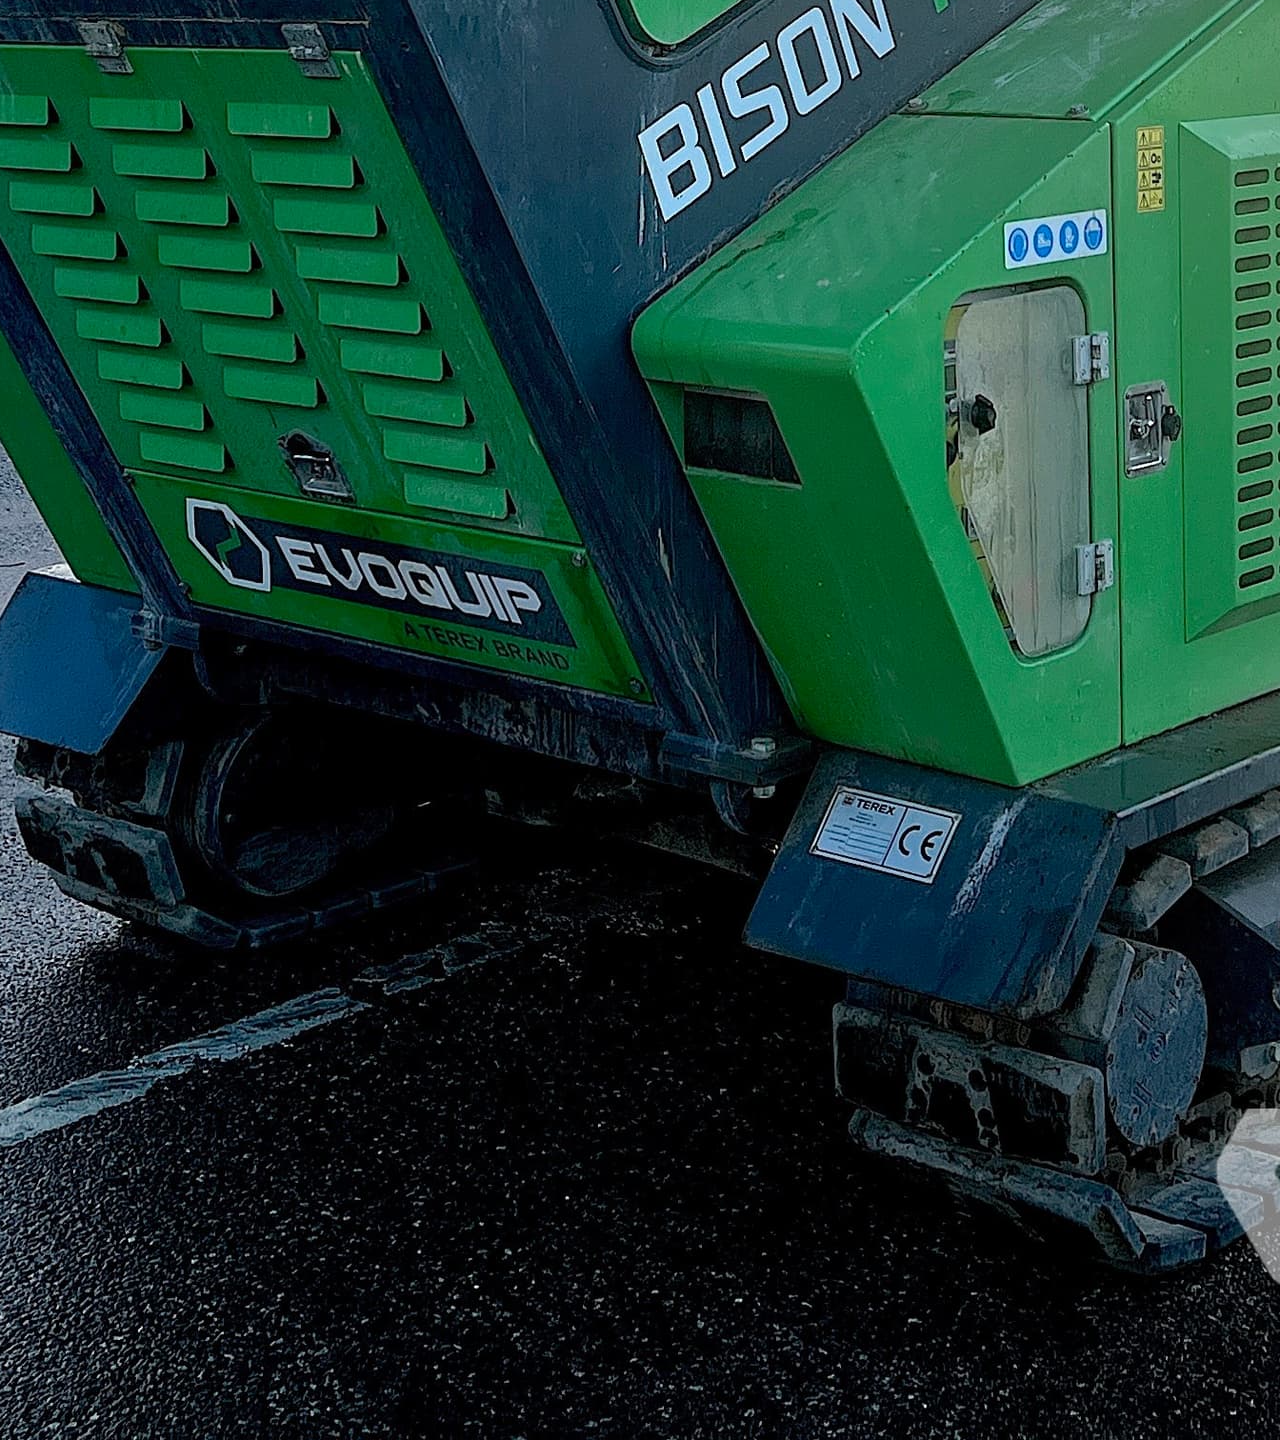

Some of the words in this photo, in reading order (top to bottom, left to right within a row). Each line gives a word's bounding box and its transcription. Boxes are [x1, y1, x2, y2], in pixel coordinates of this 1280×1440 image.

[275, 535, 542, 625] EVOQUIP
[404, 621, 418, 640] A
[419, 623, 487, 655] TEREX
[495, 640, 571, 672] BRAND
[855, 797, 897, 816] TEREX
[898, 824, 944, 862] CE
